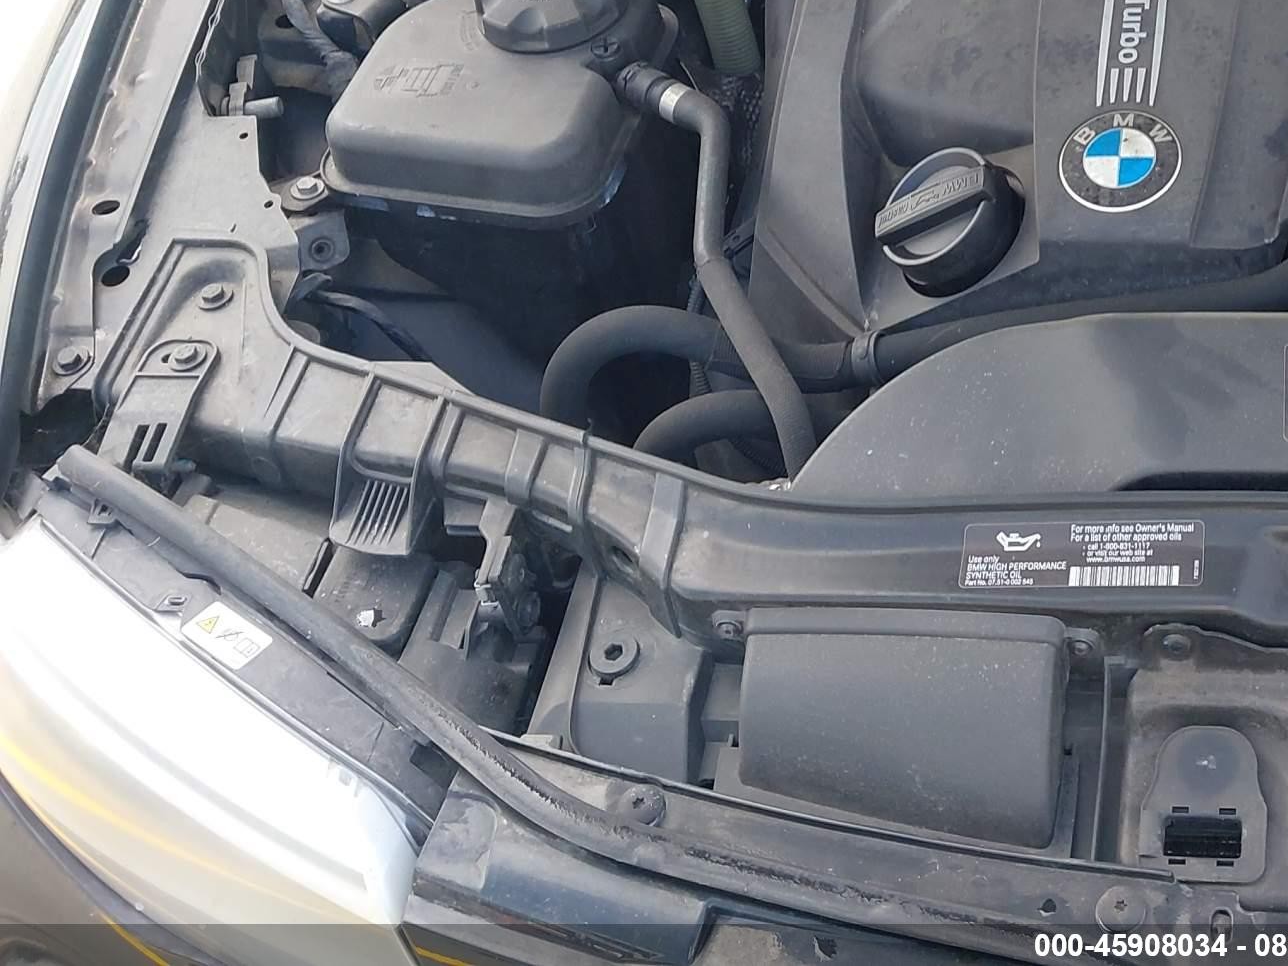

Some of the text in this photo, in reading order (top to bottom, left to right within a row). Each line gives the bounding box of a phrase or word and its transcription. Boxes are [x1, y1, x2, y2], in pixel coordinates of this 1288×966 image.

[1073, 113, 1172, 145] BMW
[1071, 524, 1083, 533] For
[1085, 525, 1104, 533] more
[1121, 525, 1134, 533] see
[1135, 523, 1166, 533] Owner's
[1167, 522, 1194, 532] Manual
[1071, 534, 1083, 542] For
[1091, 533, 1101, 542] list
[1103, 533, 1111, 542] of
[1112, 533, 1132, 542] other
[1133, 532, 1168, 542] approved
[1088, 542, 1099, 550] call
[1146, 548, 1154, 556] at
[968, 554, 1000, 564] Use only
[967, 561, 1067, 572] BMW HIGH PERFORMANCE
[966, 570, 1022, 580] SYNTHETIC OIL
